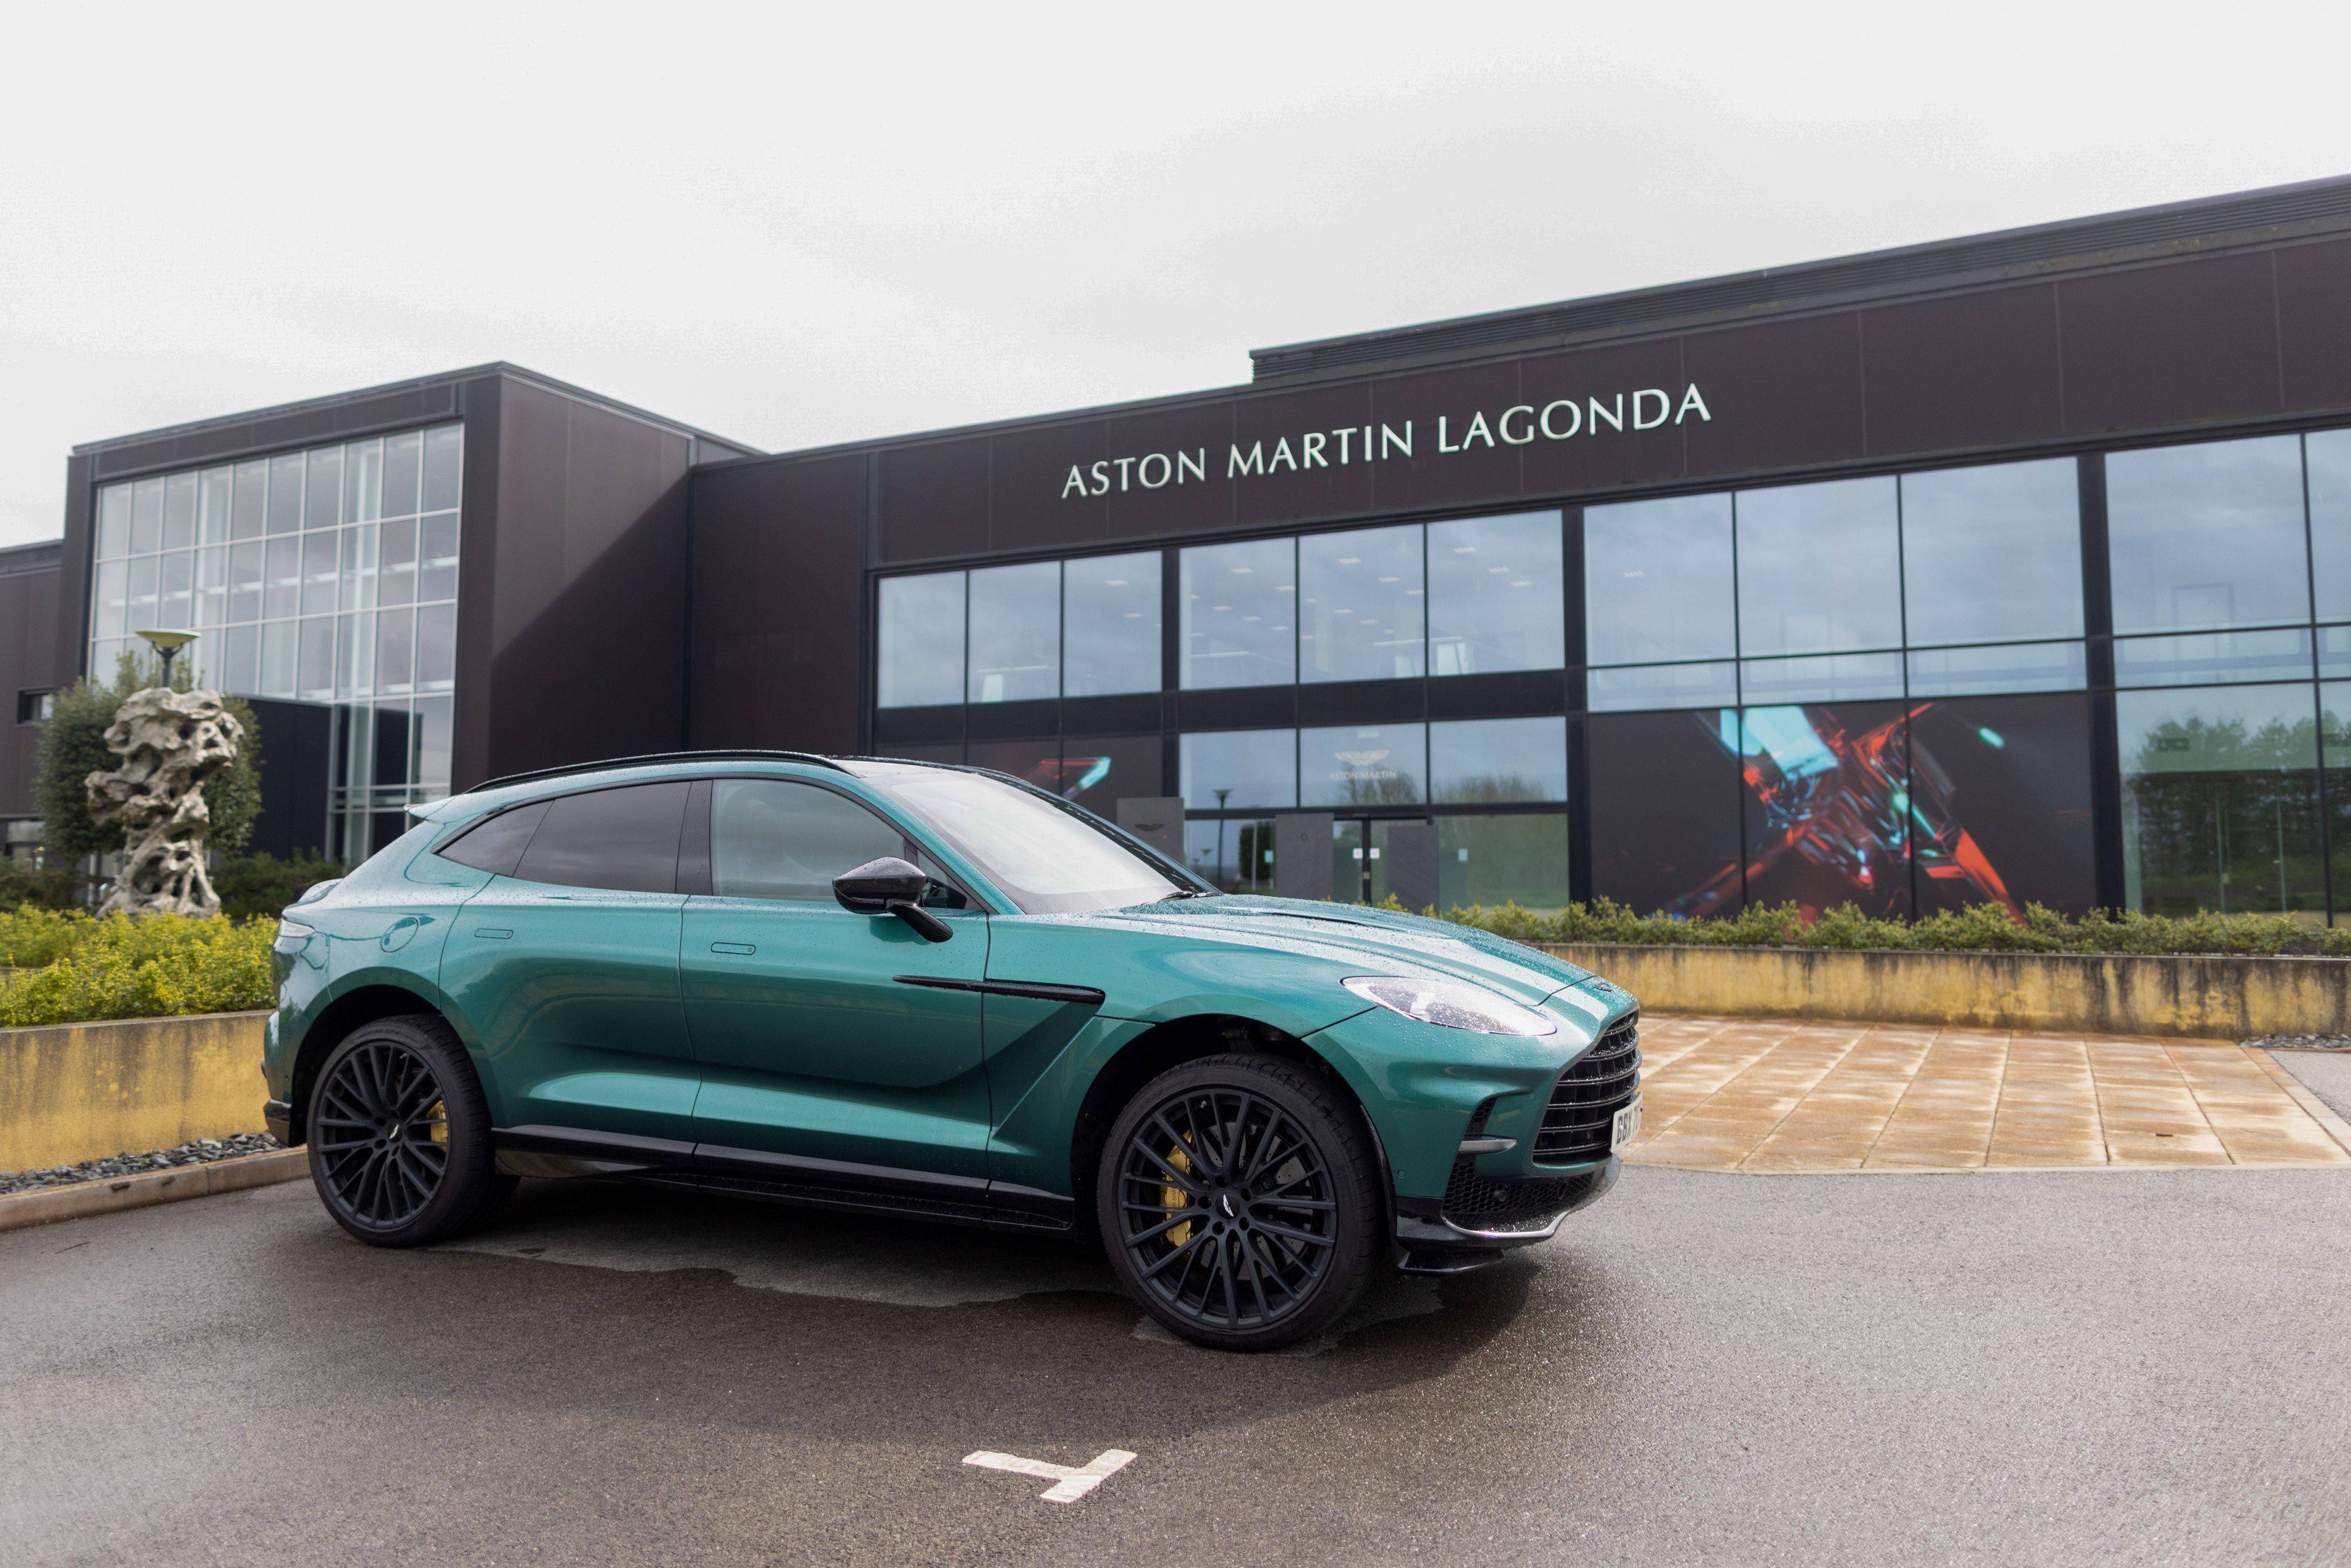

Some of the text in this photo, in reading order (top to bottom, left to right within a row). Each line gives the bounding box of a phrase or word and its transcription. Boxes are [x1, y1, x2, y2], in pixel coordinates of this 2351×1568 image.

[1062, 383, 1712, 499] ASTON MARTIN LAGONDA
[1329, 770, 1396, 781] ASTON MARTIN
